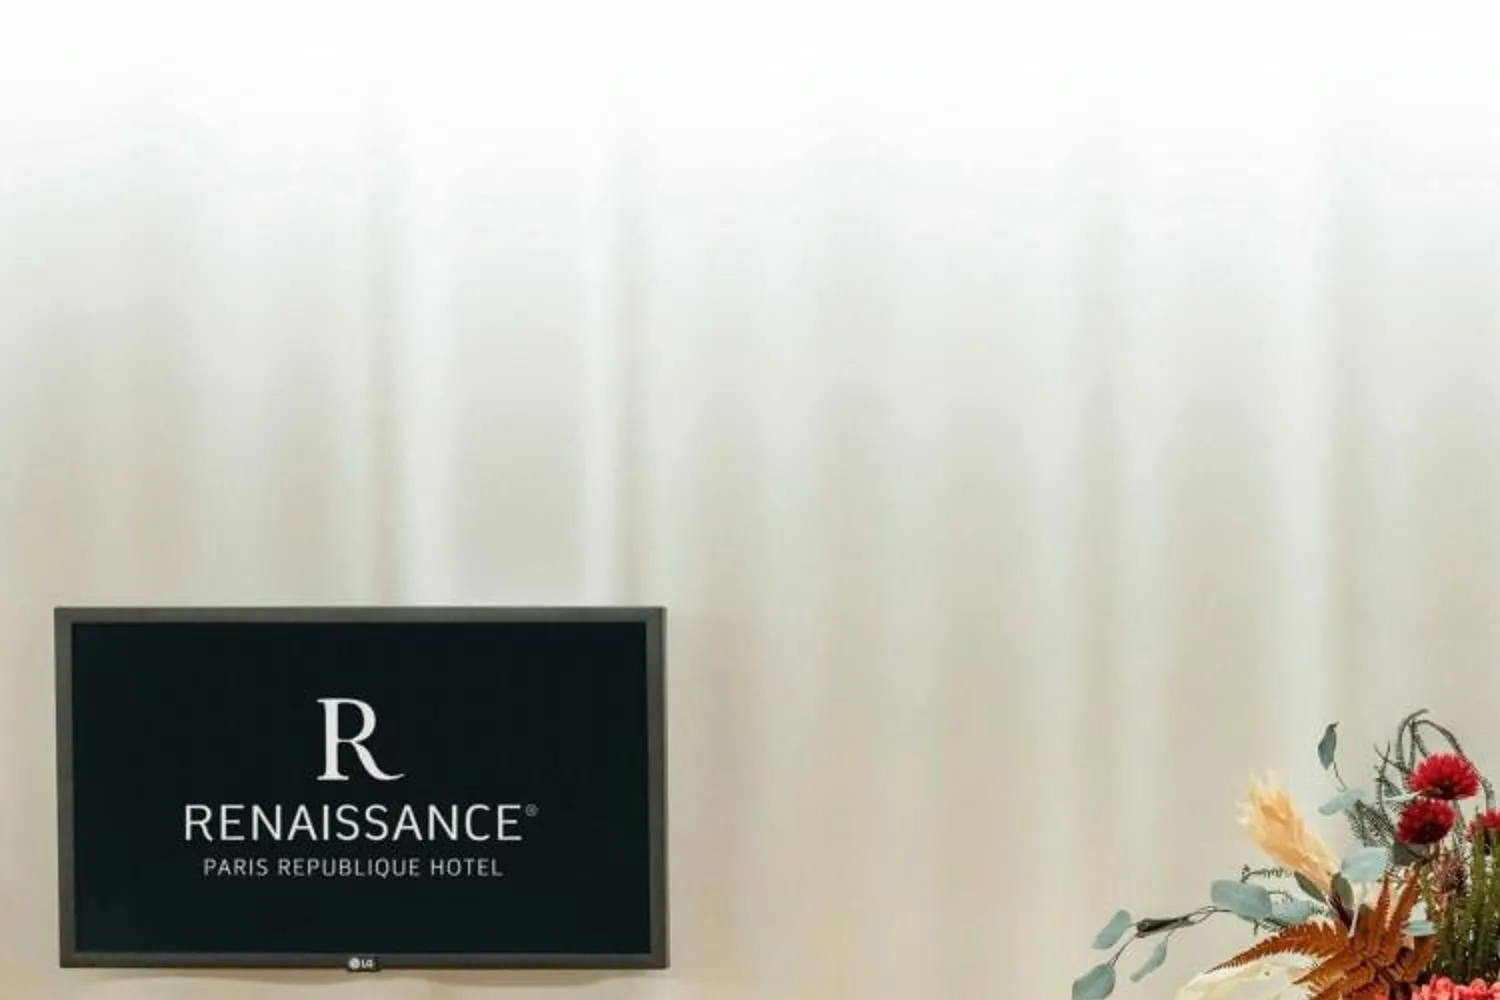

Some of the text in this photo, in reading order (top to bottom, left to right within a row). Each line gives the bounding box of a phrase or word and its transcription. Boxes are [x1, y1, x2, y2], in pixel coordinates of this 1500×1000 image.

[316, 697, 406, 781] R
[203, 857, 503, 879] PARIS REPUBLIQUE HOTEL
